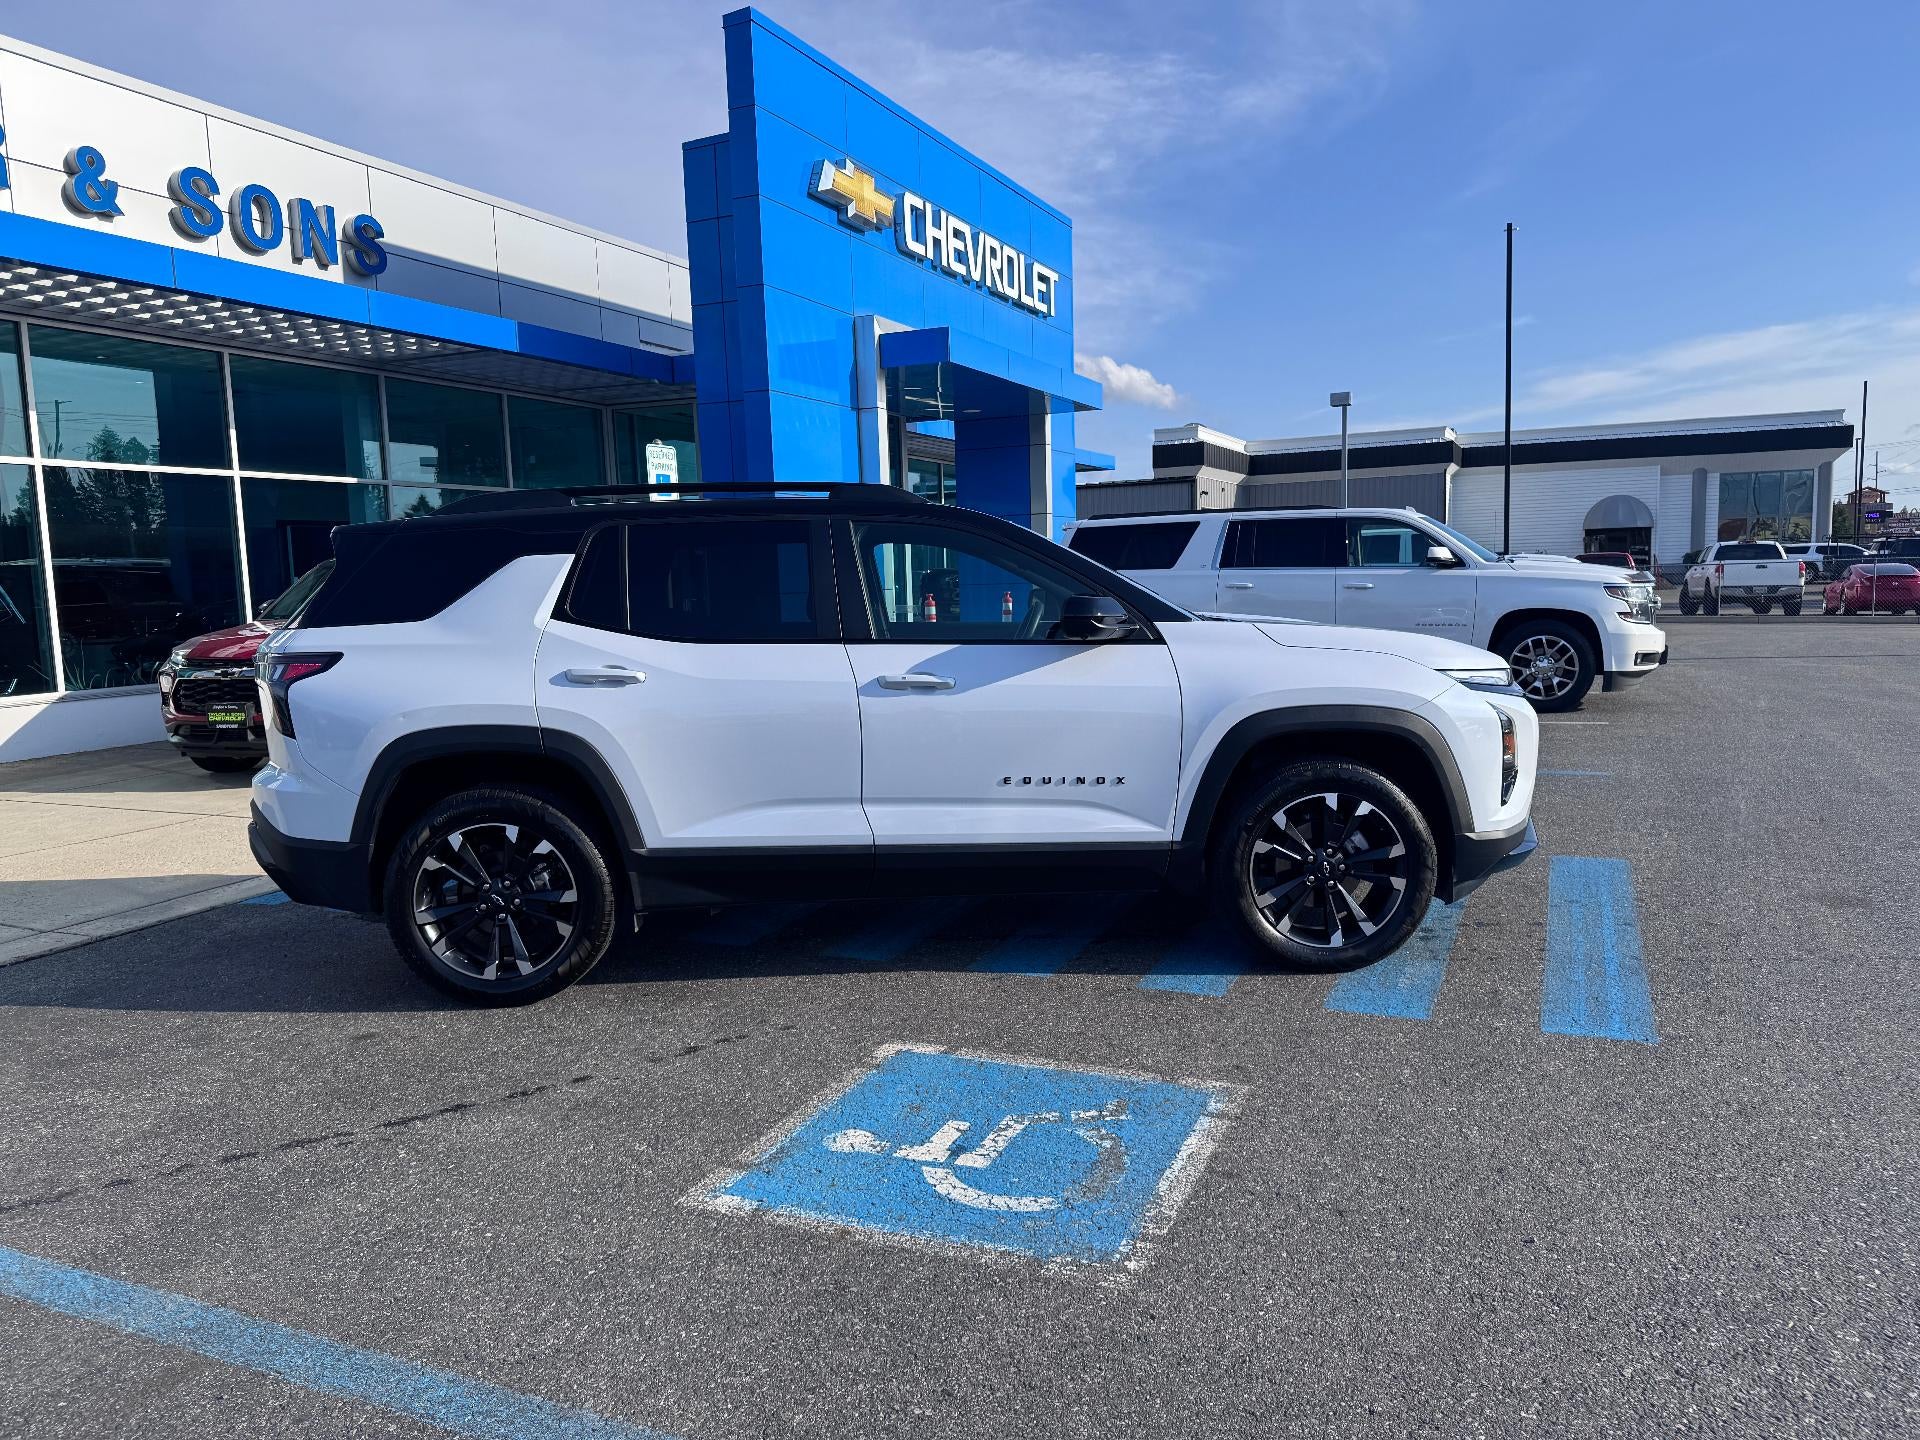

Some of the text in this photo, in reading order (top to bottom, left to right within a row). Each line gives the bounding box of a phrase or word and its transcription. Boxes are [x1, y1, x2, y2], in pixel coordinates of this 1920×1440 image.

[64, 146, 124, 221] &
[169, 167, 387, 276] SONS
[897, 191, 1059, 318] CHEVROLET
[649, 449, 674, 461] RESERVED
[651, 461, 674, 472] PARKING
[1003, 776, 1126, 785] EQUINOX
